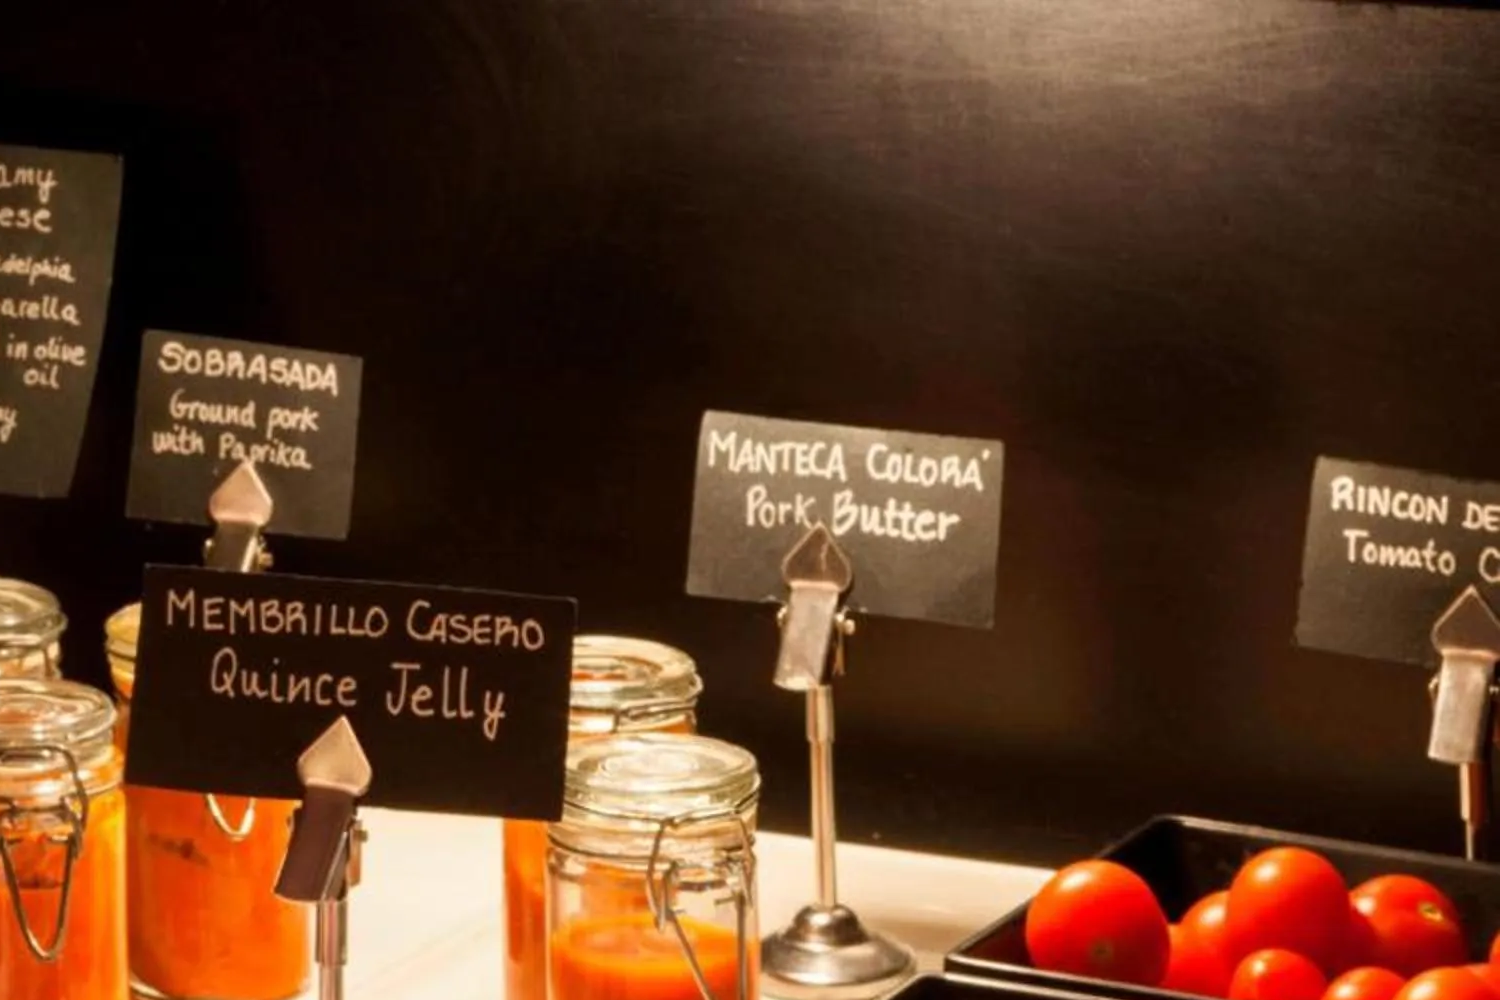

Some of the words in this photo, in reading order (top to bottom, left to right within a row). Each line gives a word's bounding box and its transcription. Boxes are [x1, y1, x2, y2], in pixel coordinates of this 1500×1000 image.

[6, 332, 28, 361] in
[33, 336, 87, 367] olive
[158, 341, 339, 397] SOBRASADA
[22, 363, 60, 390] oil
[169, 388, 257, 429] Ground
[266, 405, 320, 440] pork
[152, 424, 205, 455] with
[219, 432, 314, 471] Paprika
[707, 429, 849, 483] MANTECA
[746, 484, 817, 529] Pork
[831, 489, 961, 542] Butter
[1331, 474, 1449, 526] RINCON
[1343, 529, 1457, 576] Tomato
[165, 589, 390, 640] MEMBRILLO
[405, 600, 547, 651] CASERO
[210, 646, 358, 708] Quince
[385, 662, 506, 741] Jelly
